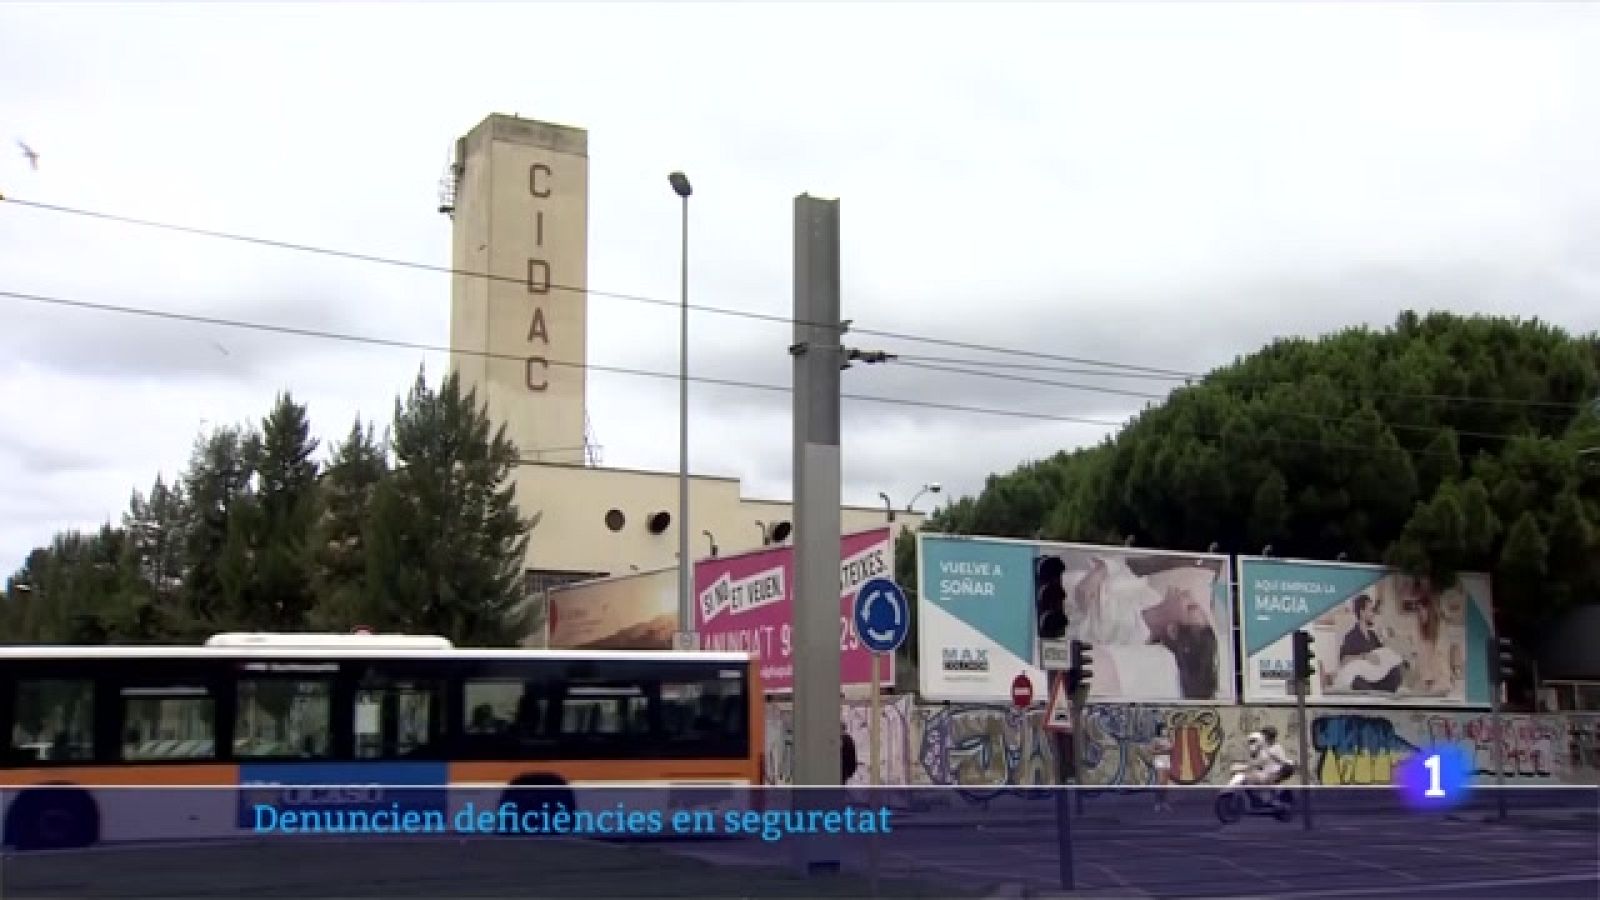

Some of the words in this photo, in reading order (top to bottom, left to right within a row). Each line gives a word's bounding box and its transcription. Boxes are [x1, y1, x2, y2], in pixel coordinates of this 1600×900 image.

[526, 163, 552, 391] CIDAC
[939, 559, 988, 576] VUELVE
[991, 564, 1003, 577] A
[940, 577, 995, 596] SOÑAR
[1254, 594, 1309, 614] MAGIA
[943, 646, 989, 661] MAX
